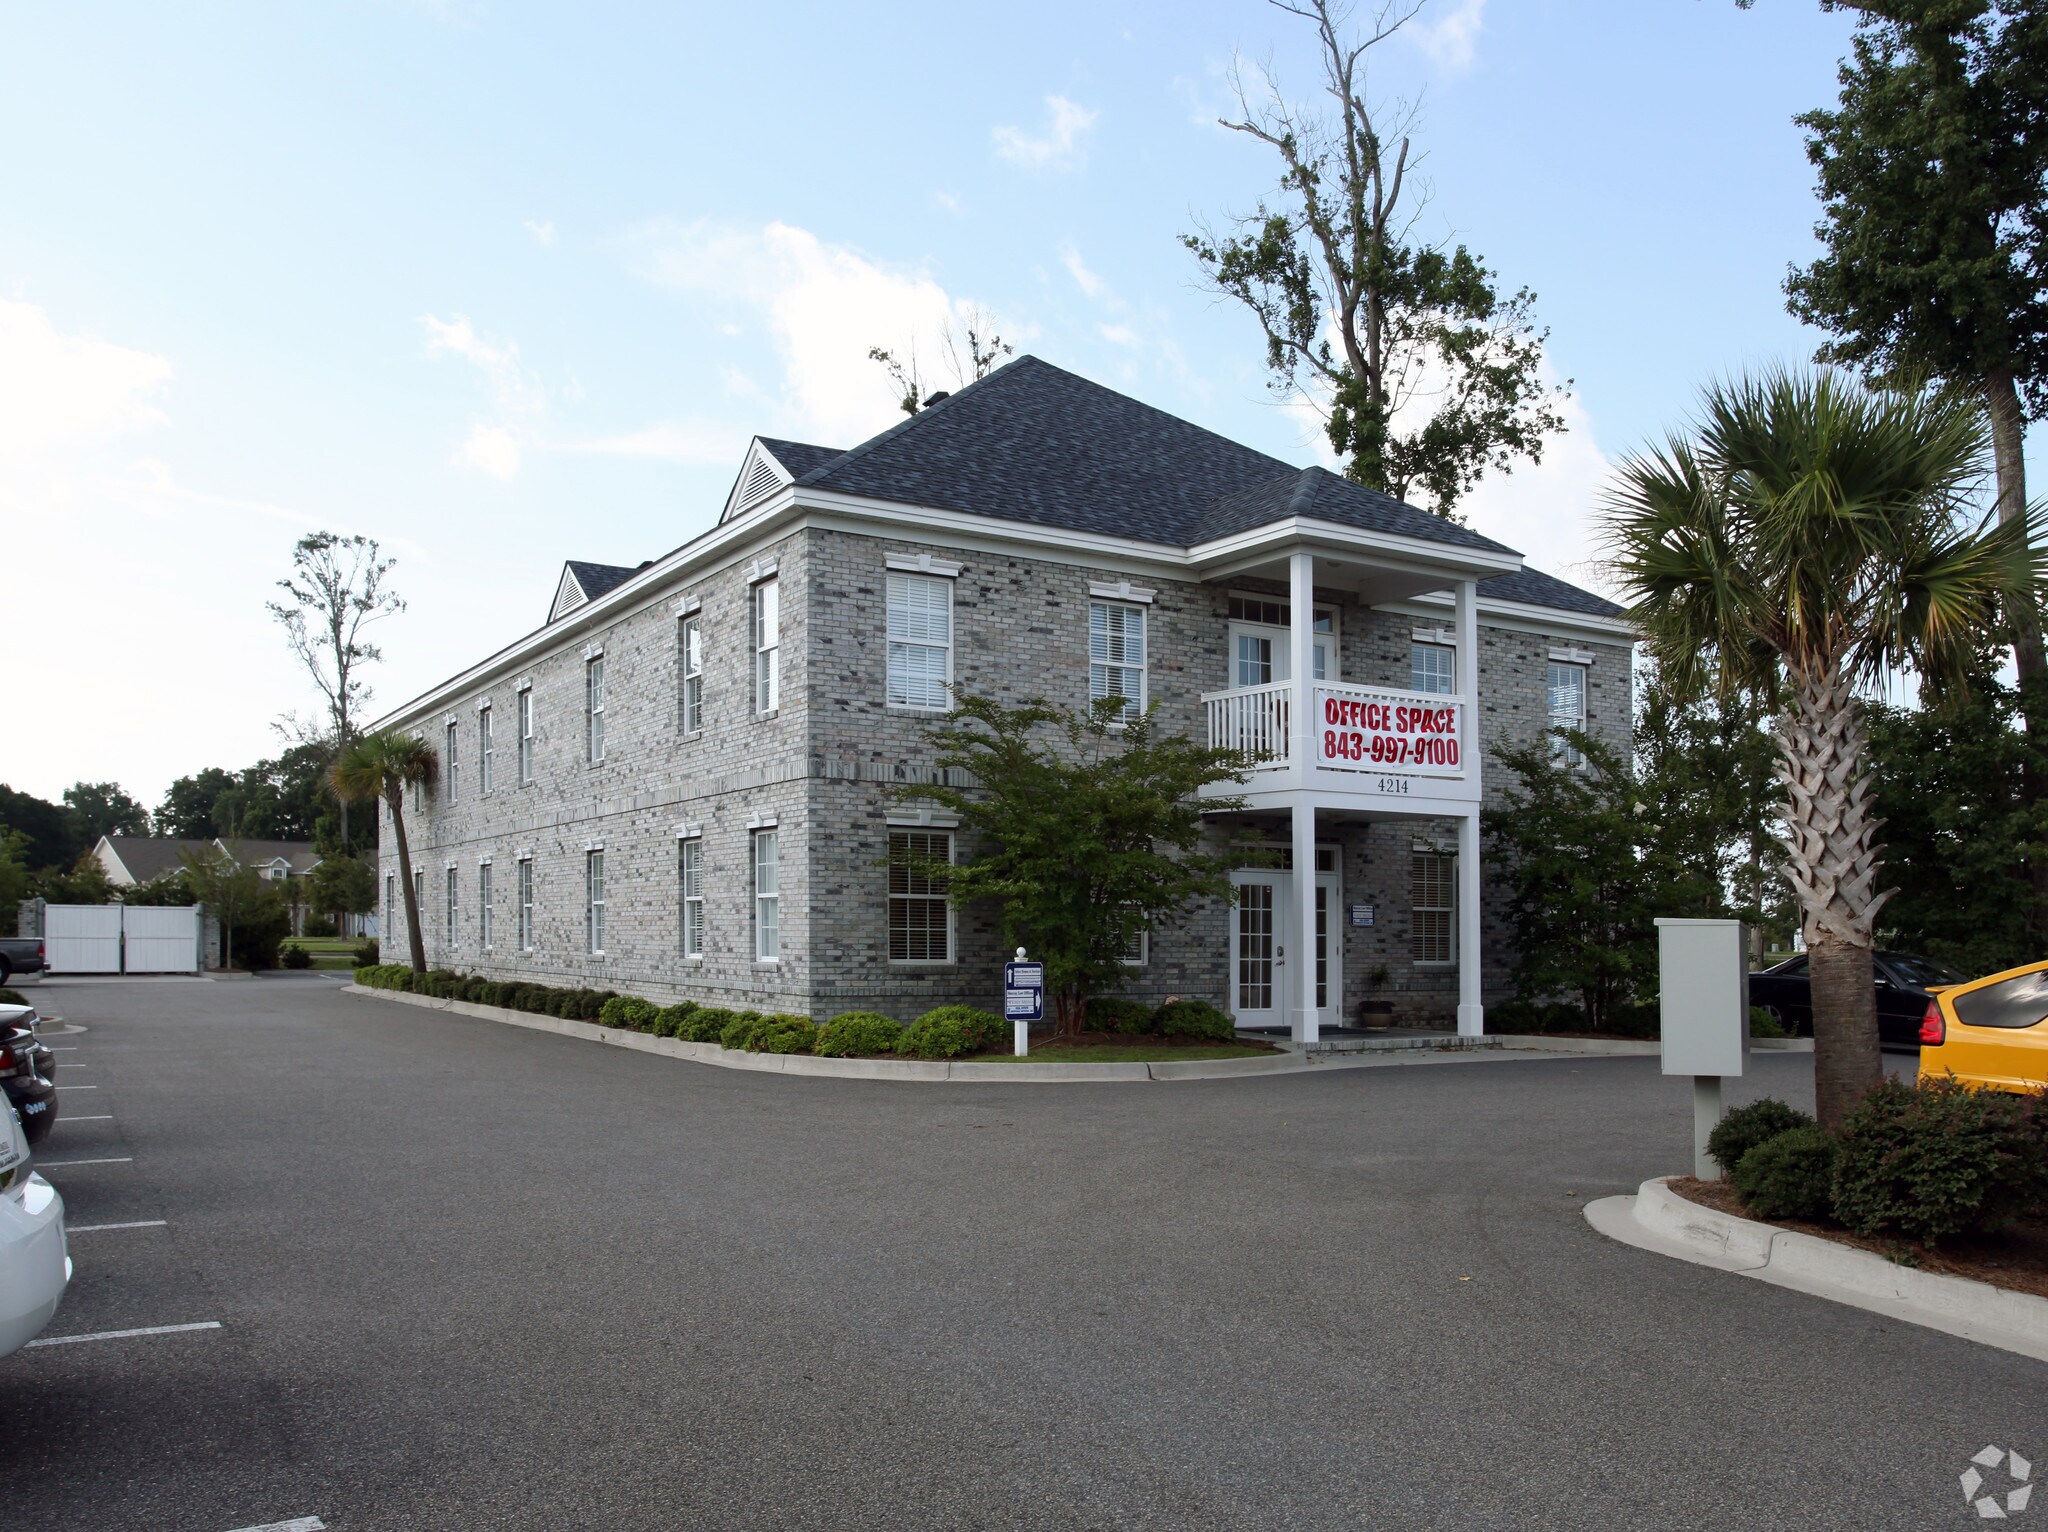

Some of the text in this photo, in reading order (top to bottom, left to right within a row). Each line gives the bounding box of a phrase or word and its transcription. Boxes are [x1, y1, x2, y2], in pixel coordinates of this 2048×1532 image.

[1325, 698, 1455, 733] OFFICE SPACE
[1324, 730, 1459, 765] 843-997-9100
[1378, 778, 1408, 793] 4214
